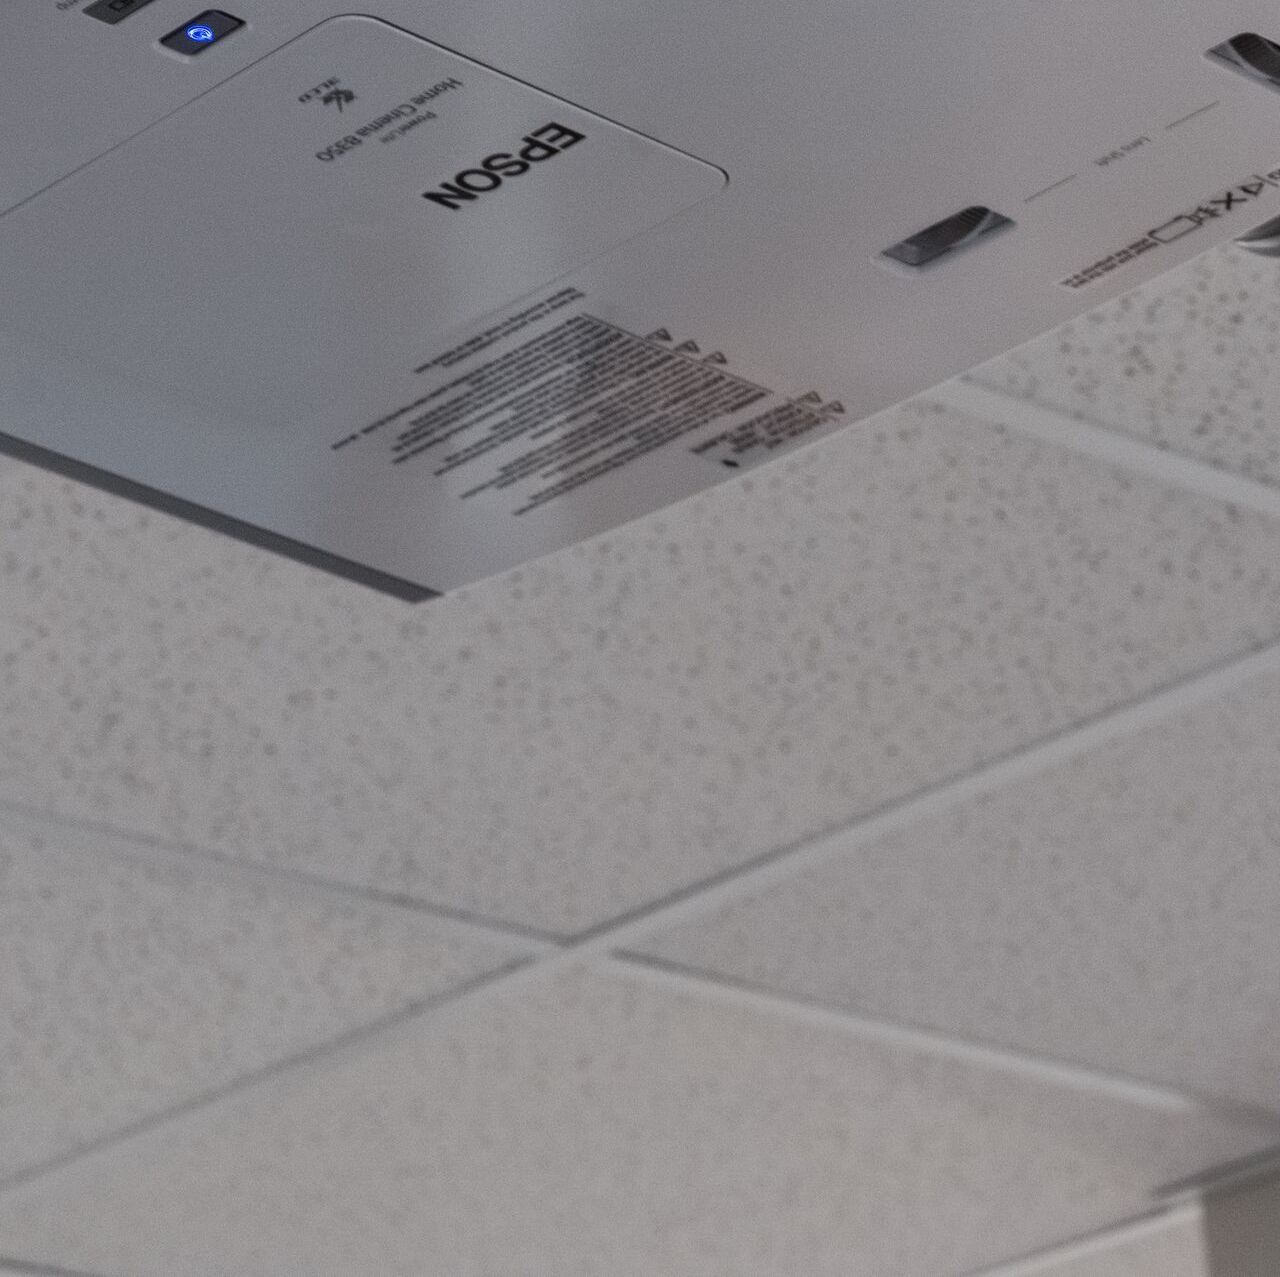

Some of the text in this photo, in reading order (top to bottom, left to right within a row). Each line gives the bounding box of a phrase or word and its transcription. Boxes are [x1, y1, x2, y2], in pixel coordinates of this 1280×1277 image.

[314, 77, 463, 162] Home Cinema 8350
[422, 121, 587, 211] EPSON
